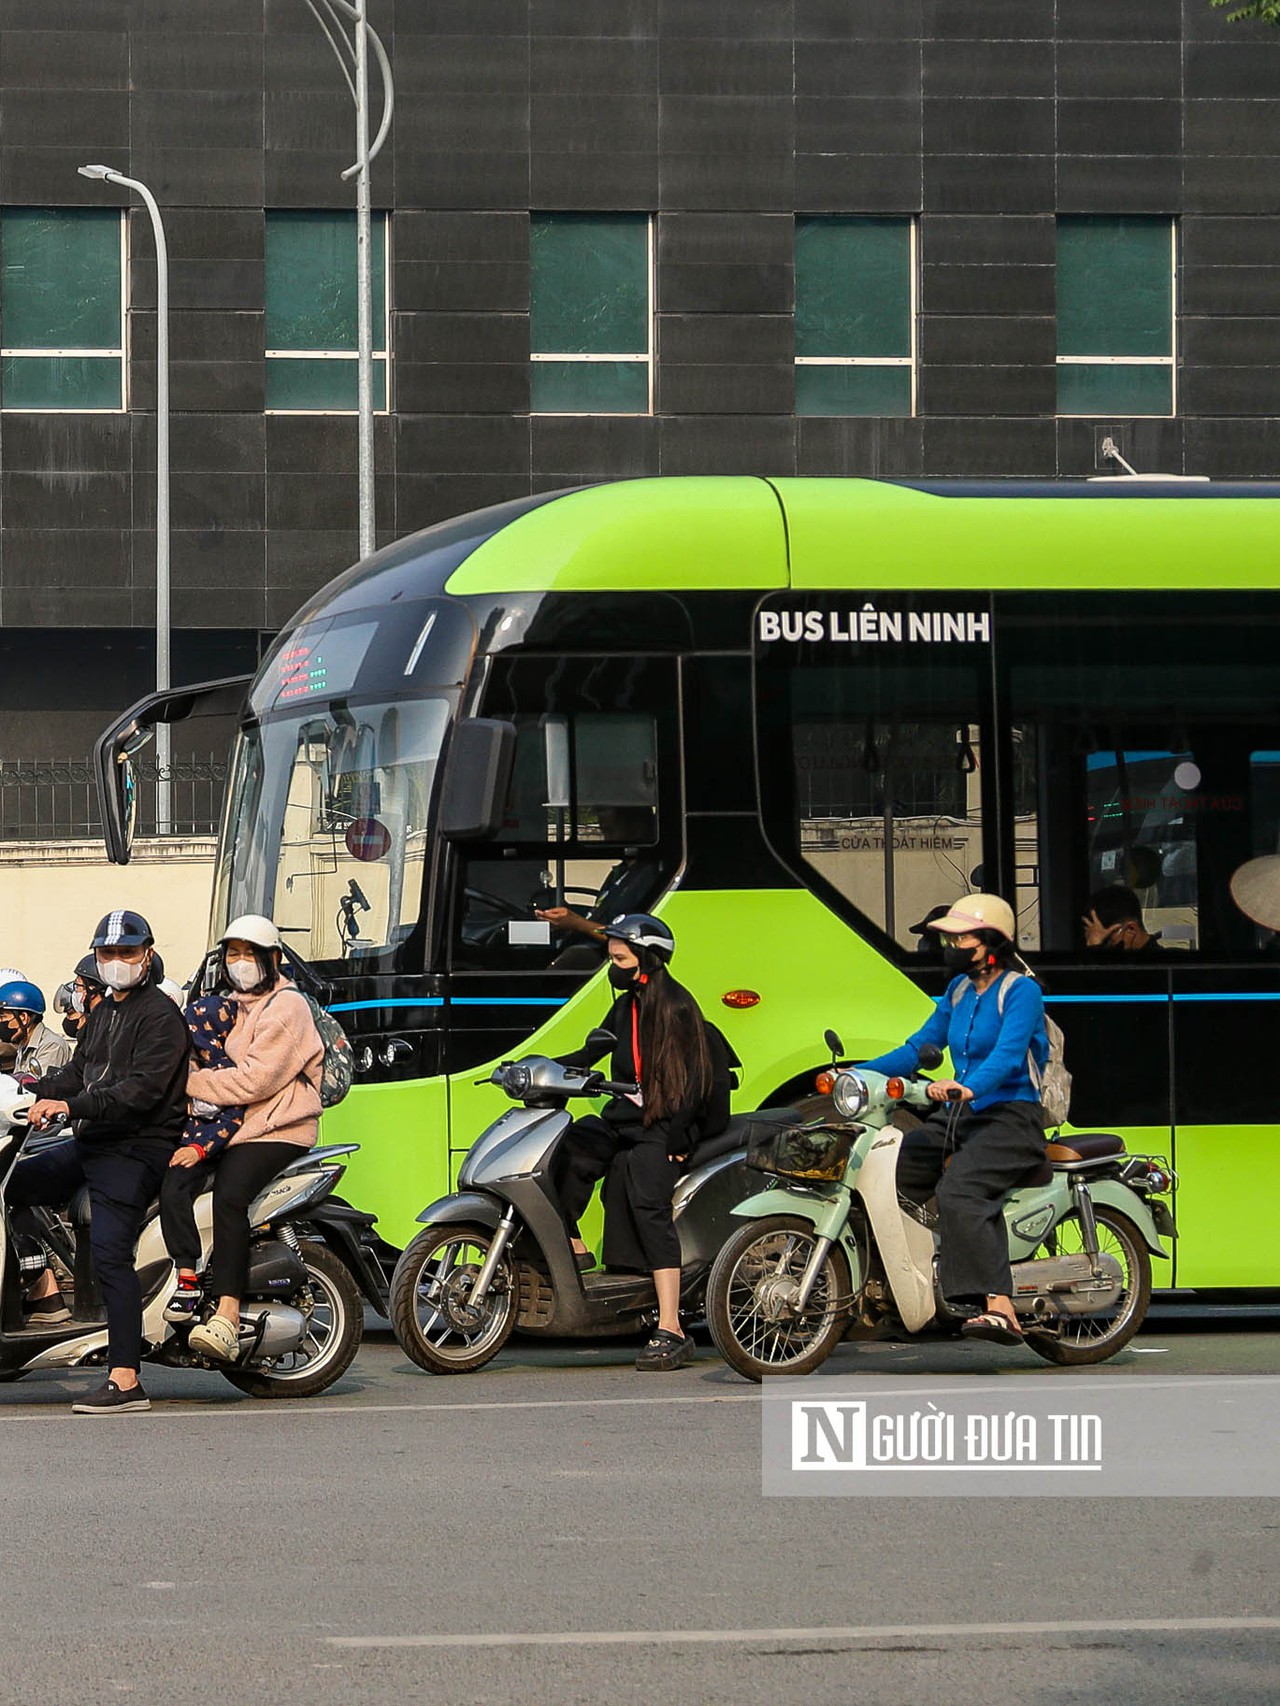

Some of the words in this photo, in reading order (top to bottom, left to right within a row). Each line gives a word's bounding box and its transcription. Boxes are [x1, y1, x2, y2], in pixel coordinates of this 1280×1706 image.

[760, 611, 824, 642] BUS
[830, 603, 902, 642] LIÊN
[909, 612, 990, 642] NINH
